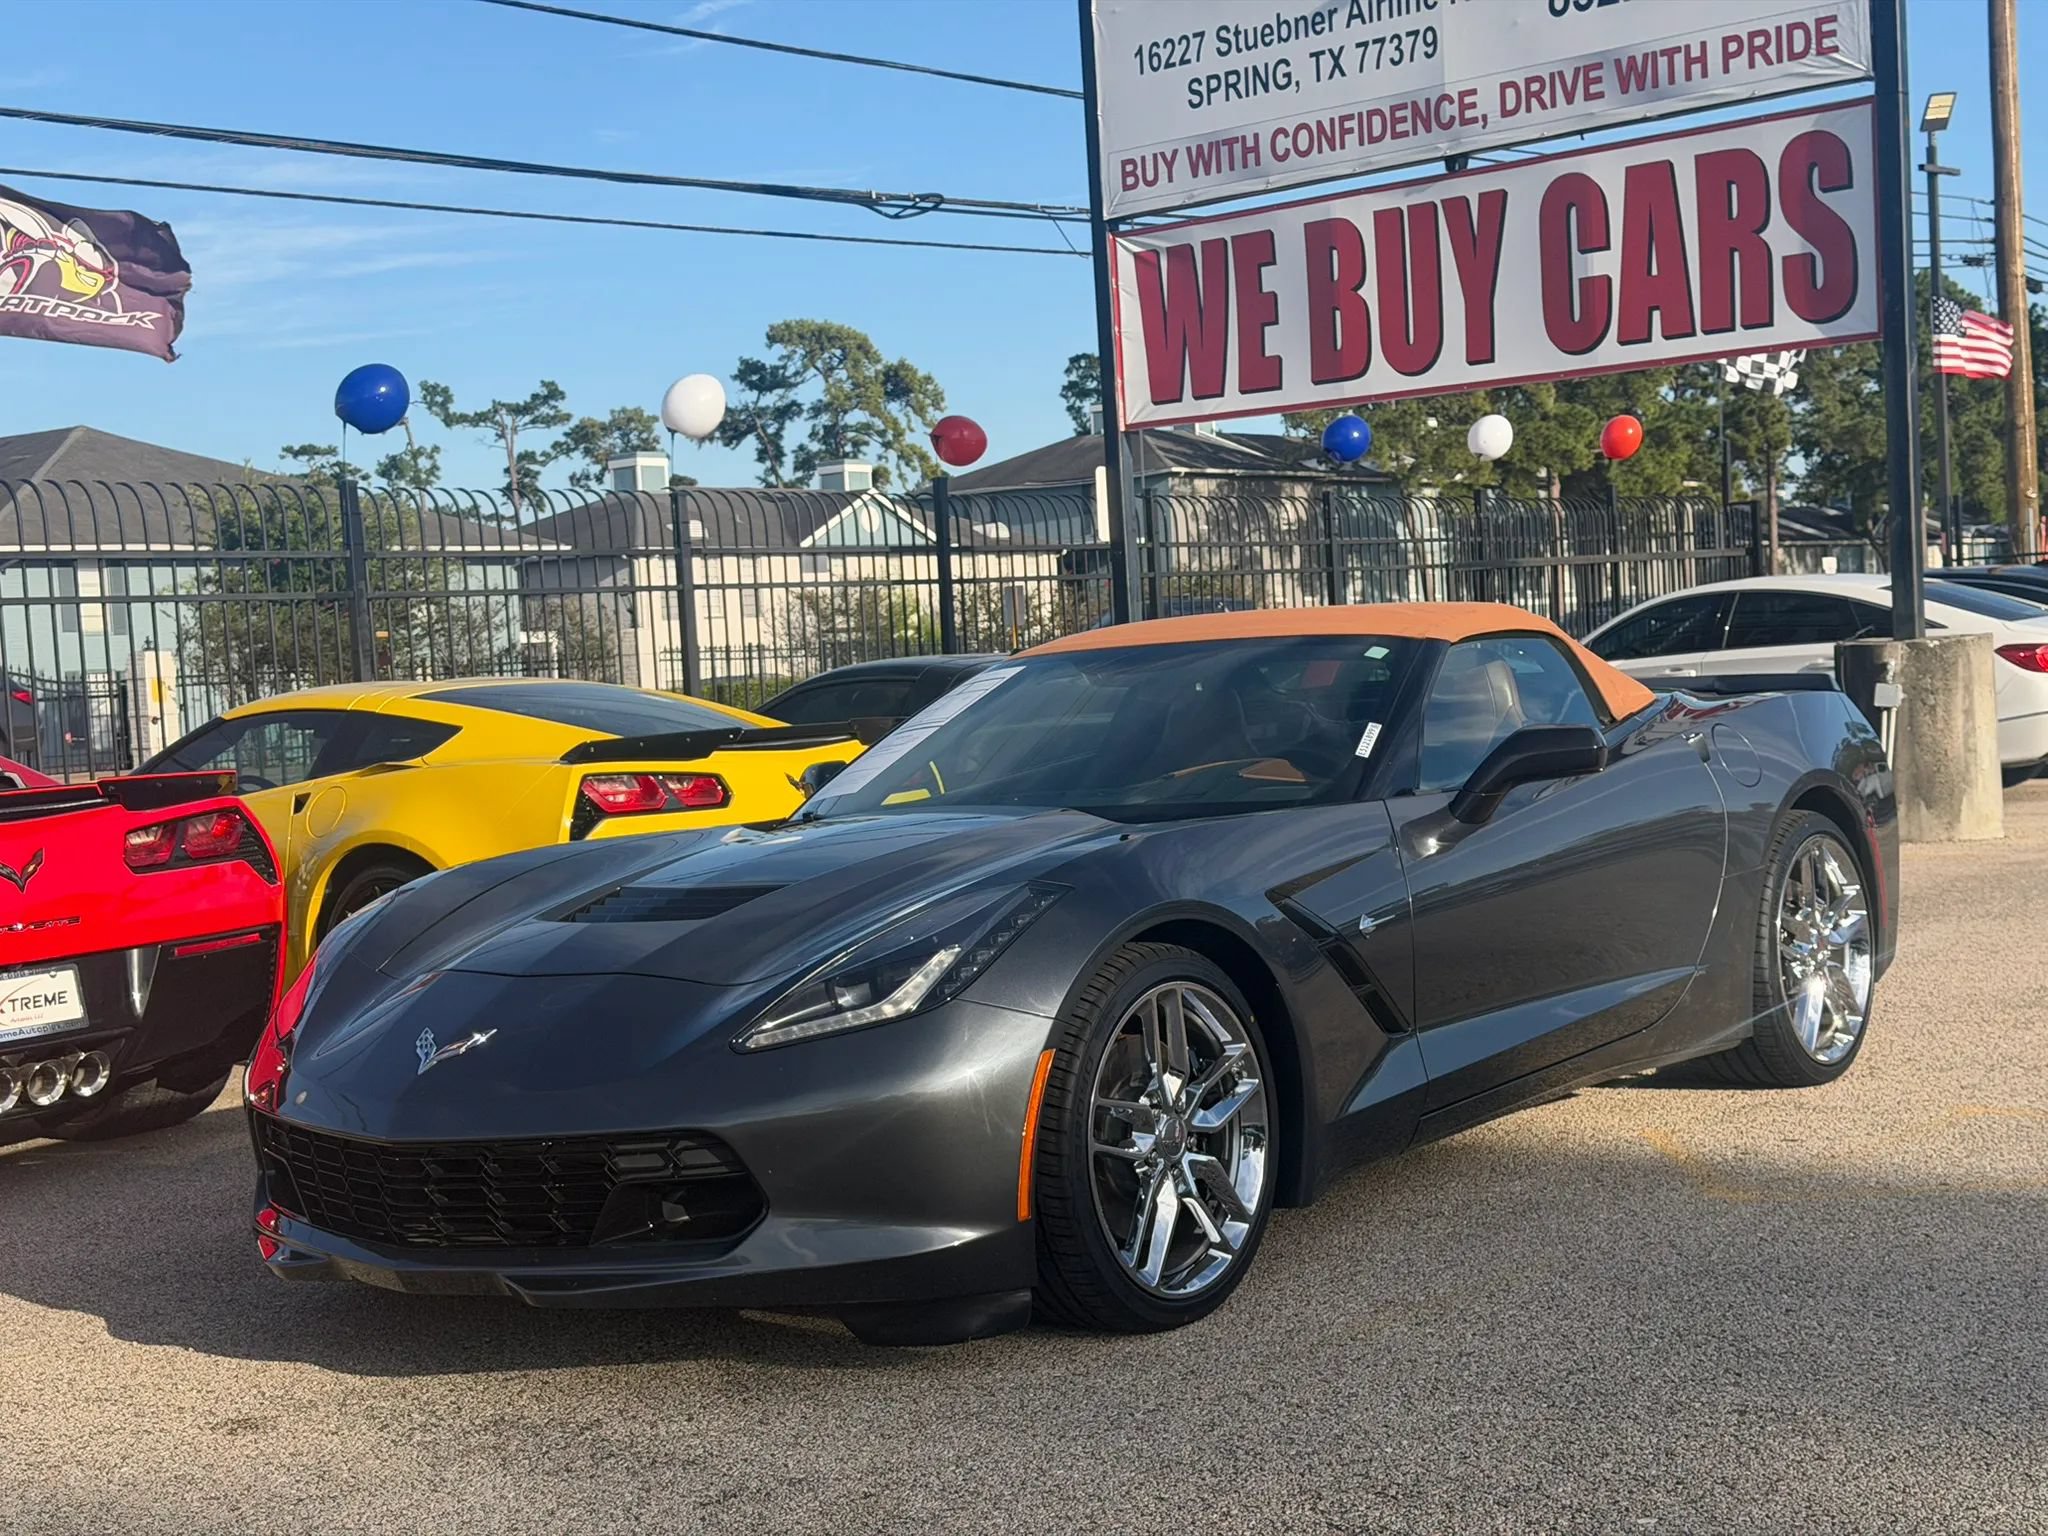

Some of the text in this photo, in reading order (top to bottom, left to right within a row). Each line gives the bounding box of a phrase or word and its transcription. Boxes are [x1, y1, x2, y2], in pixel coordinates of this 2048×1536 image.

[1121, 14, 1840, 192] BUY WITH CONFIDENCE, DRIVE WITH PRIDE
[1134, 30, 1206, 75] 16227
[1216, 6, 1339, 57] Stuebner
[1188, 26, 1439, 109] SPRING, TX 77379
[1134, 129, 1859, 405] WE BUY CARS
